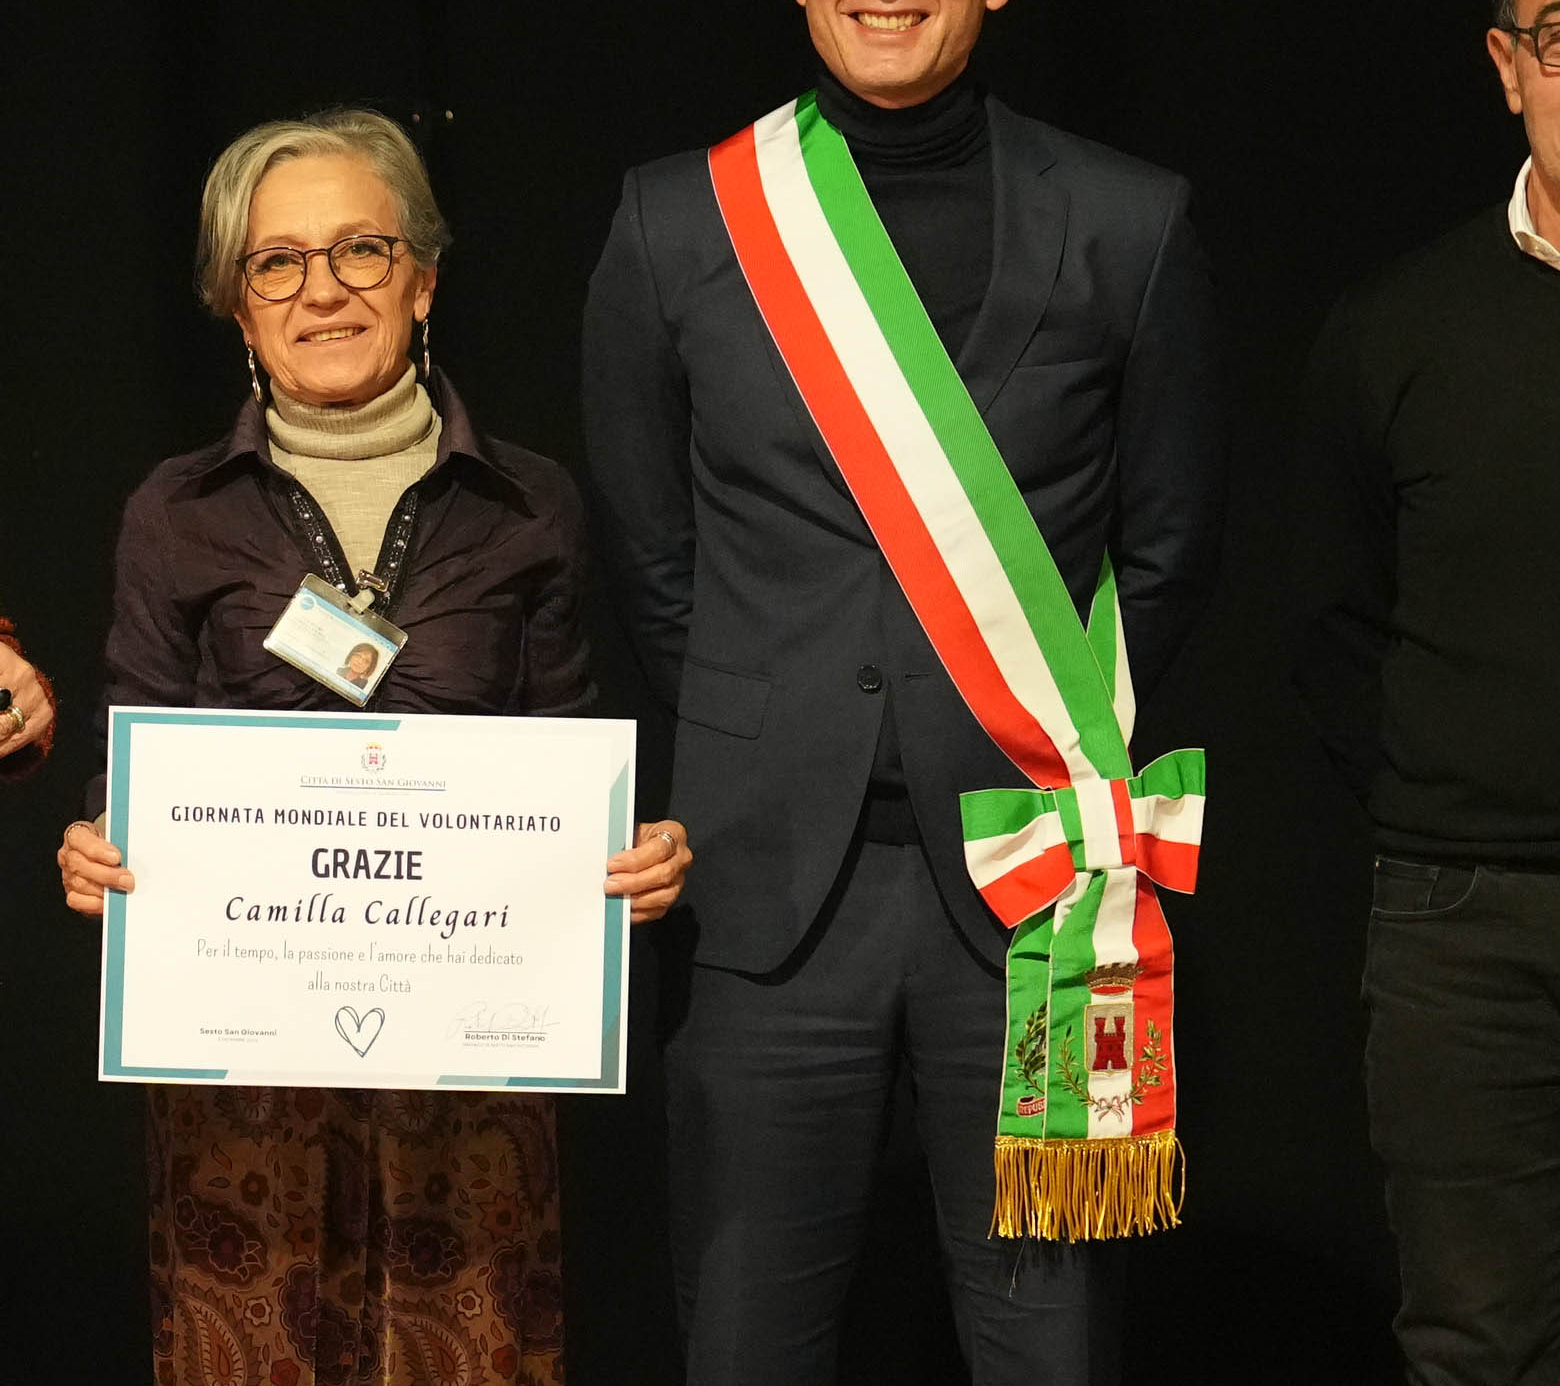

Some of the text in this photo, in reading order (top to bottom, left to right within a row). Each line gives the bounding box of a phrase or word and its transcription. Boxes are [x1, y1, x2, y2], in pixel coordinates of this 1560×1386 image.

[171, 805, 561, 833] GIORNATA MONDIALE DEL VOLONTARIATO
[311, 847, 423, 881] GRAZIE
[225, 892, 509, 940] Camilla Callegari
[197, 937, 524, 966] Per il tempo, la passione e l'amore che hai dedicato
[307, 970, 412, 994] alla nostra Città
[1018, 1098, 1045, 1115] REPUB
